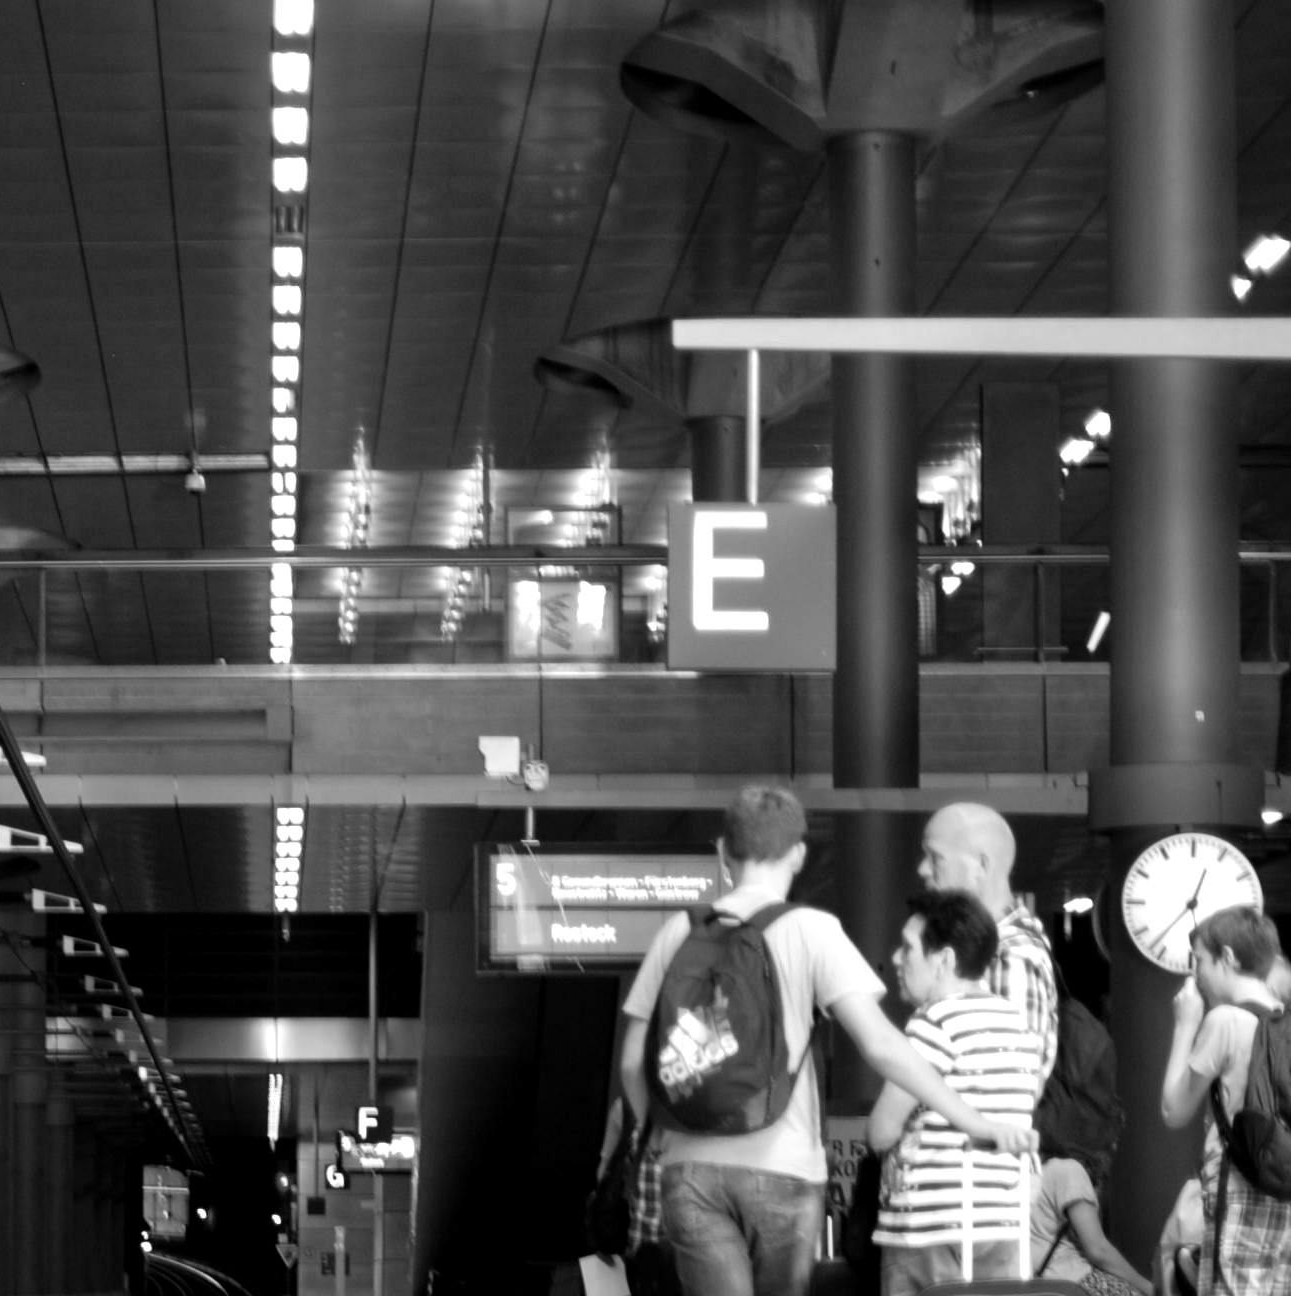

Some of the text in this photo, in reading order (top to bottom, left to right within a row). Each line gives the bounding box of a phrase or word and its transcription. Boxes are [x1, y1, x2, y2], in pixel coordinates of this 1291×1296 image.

[692, 511, 769, 632] E
[496, 862, 517, 896] 5
[358, 1106, 379, 1140] F
[325, 1164, 345, 1189] G
